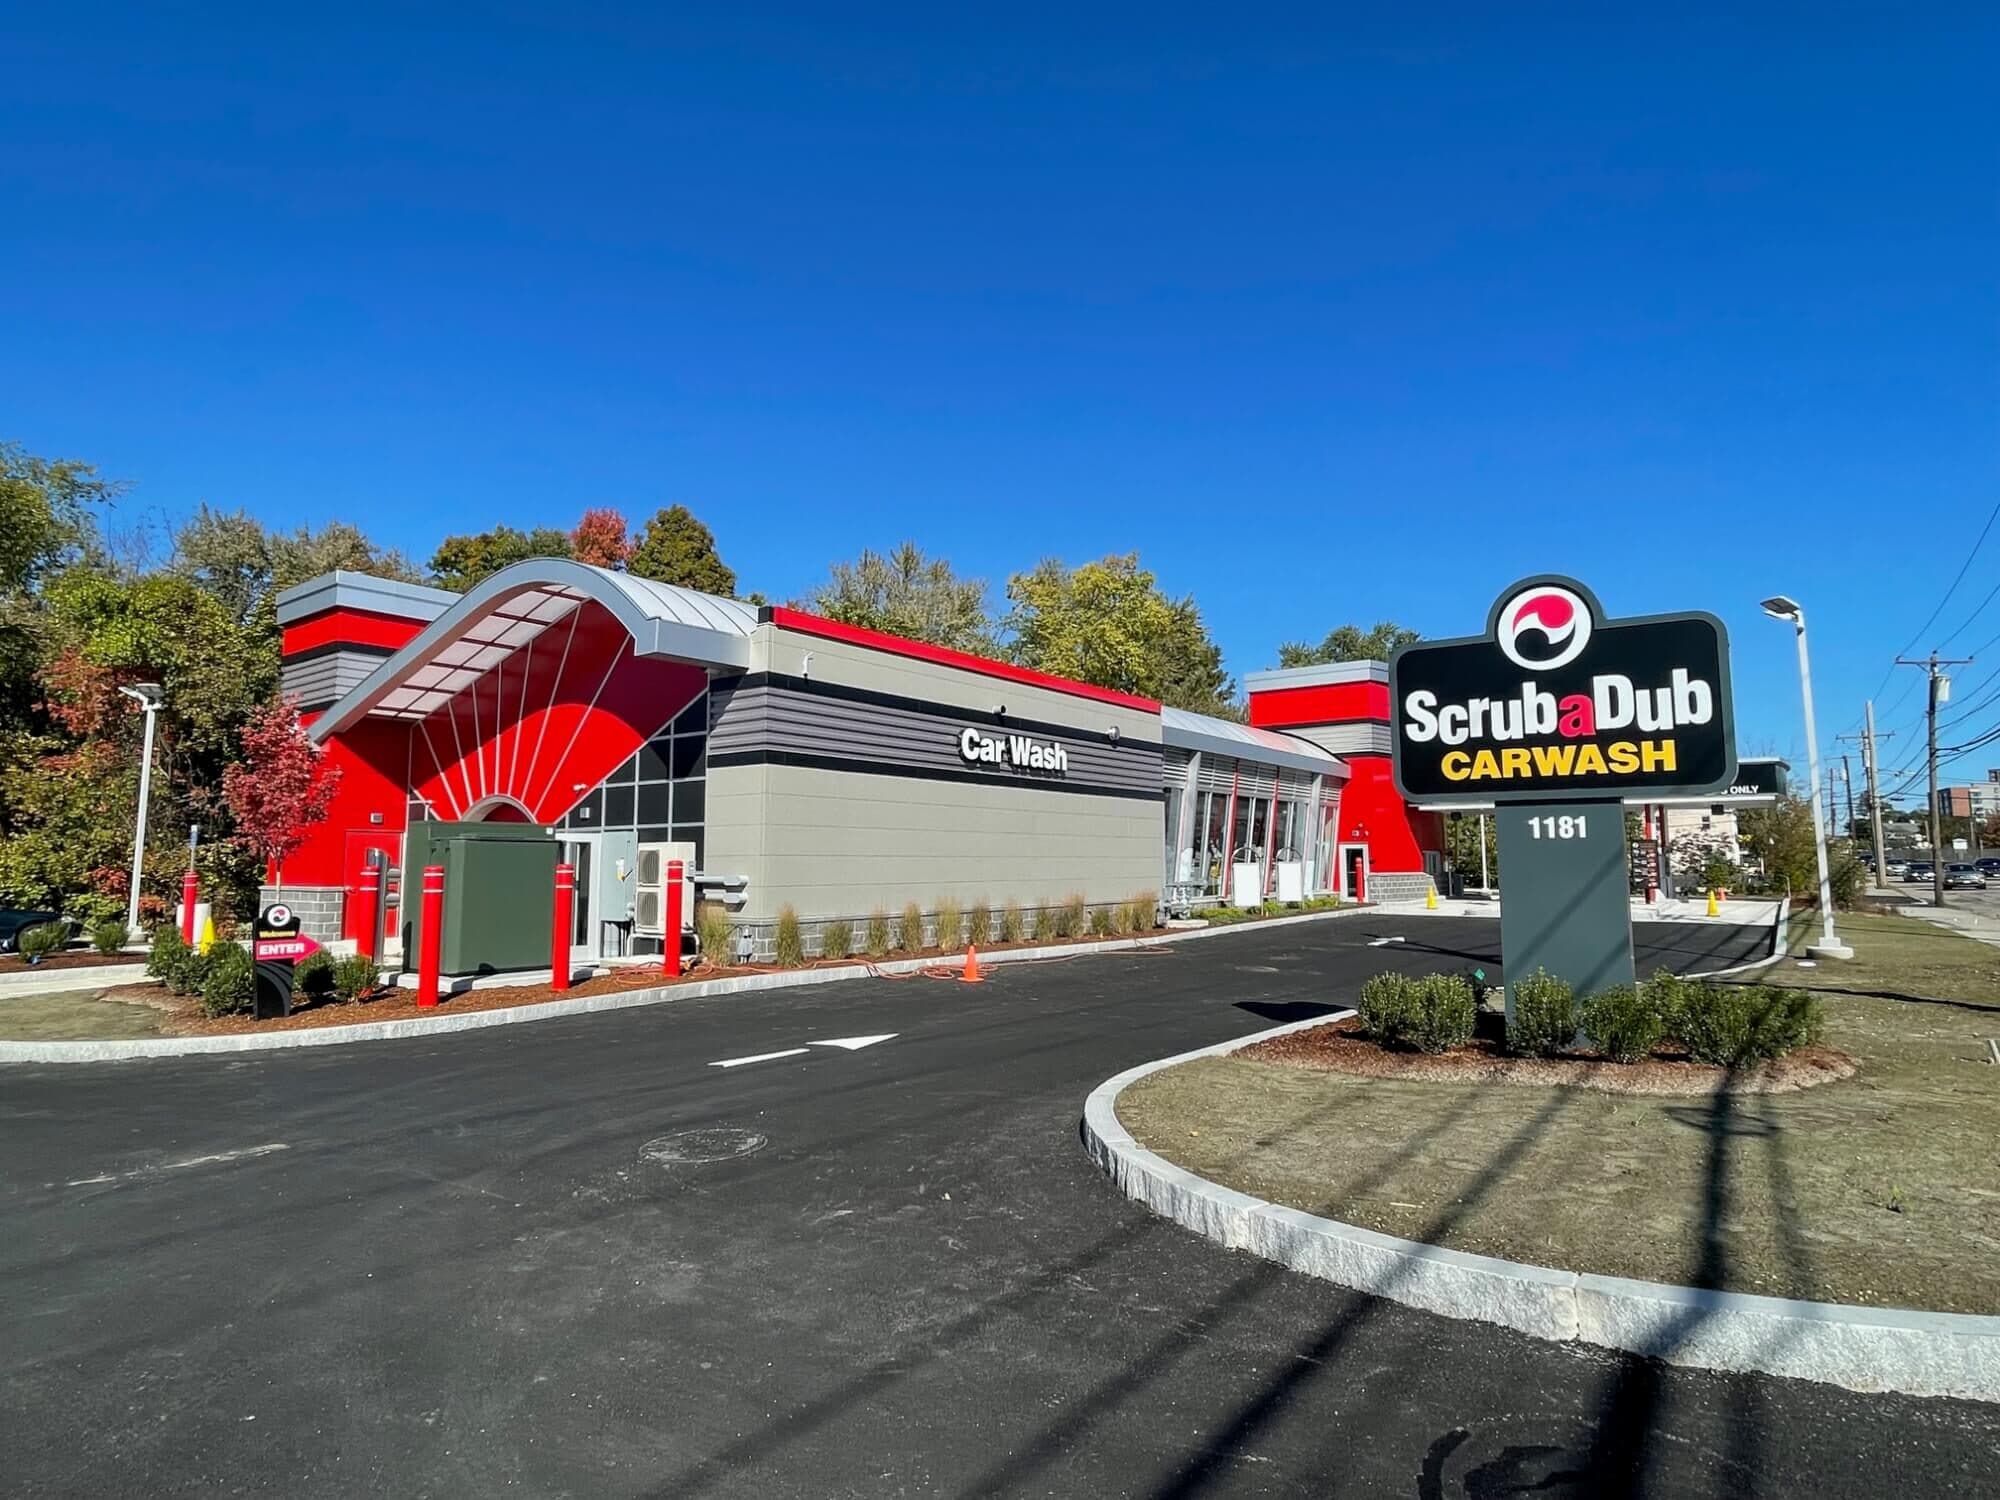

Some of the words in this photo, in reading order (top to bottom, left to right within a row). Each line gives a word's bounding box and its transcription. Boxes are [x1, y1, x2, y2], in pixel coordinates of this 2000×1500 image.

[1405, 668, 1713, 745] ScrubaDub
[961, 728, 1006, 763] Car
[1010, 735, 1068, 771] Wash
[1441, 739, 1677, 780] CARWASH
[1730, 785, 1759, 794] ONLY
[1528, 815, 1587, 839] 1181
[259, 943, 304, 956] ENTER
